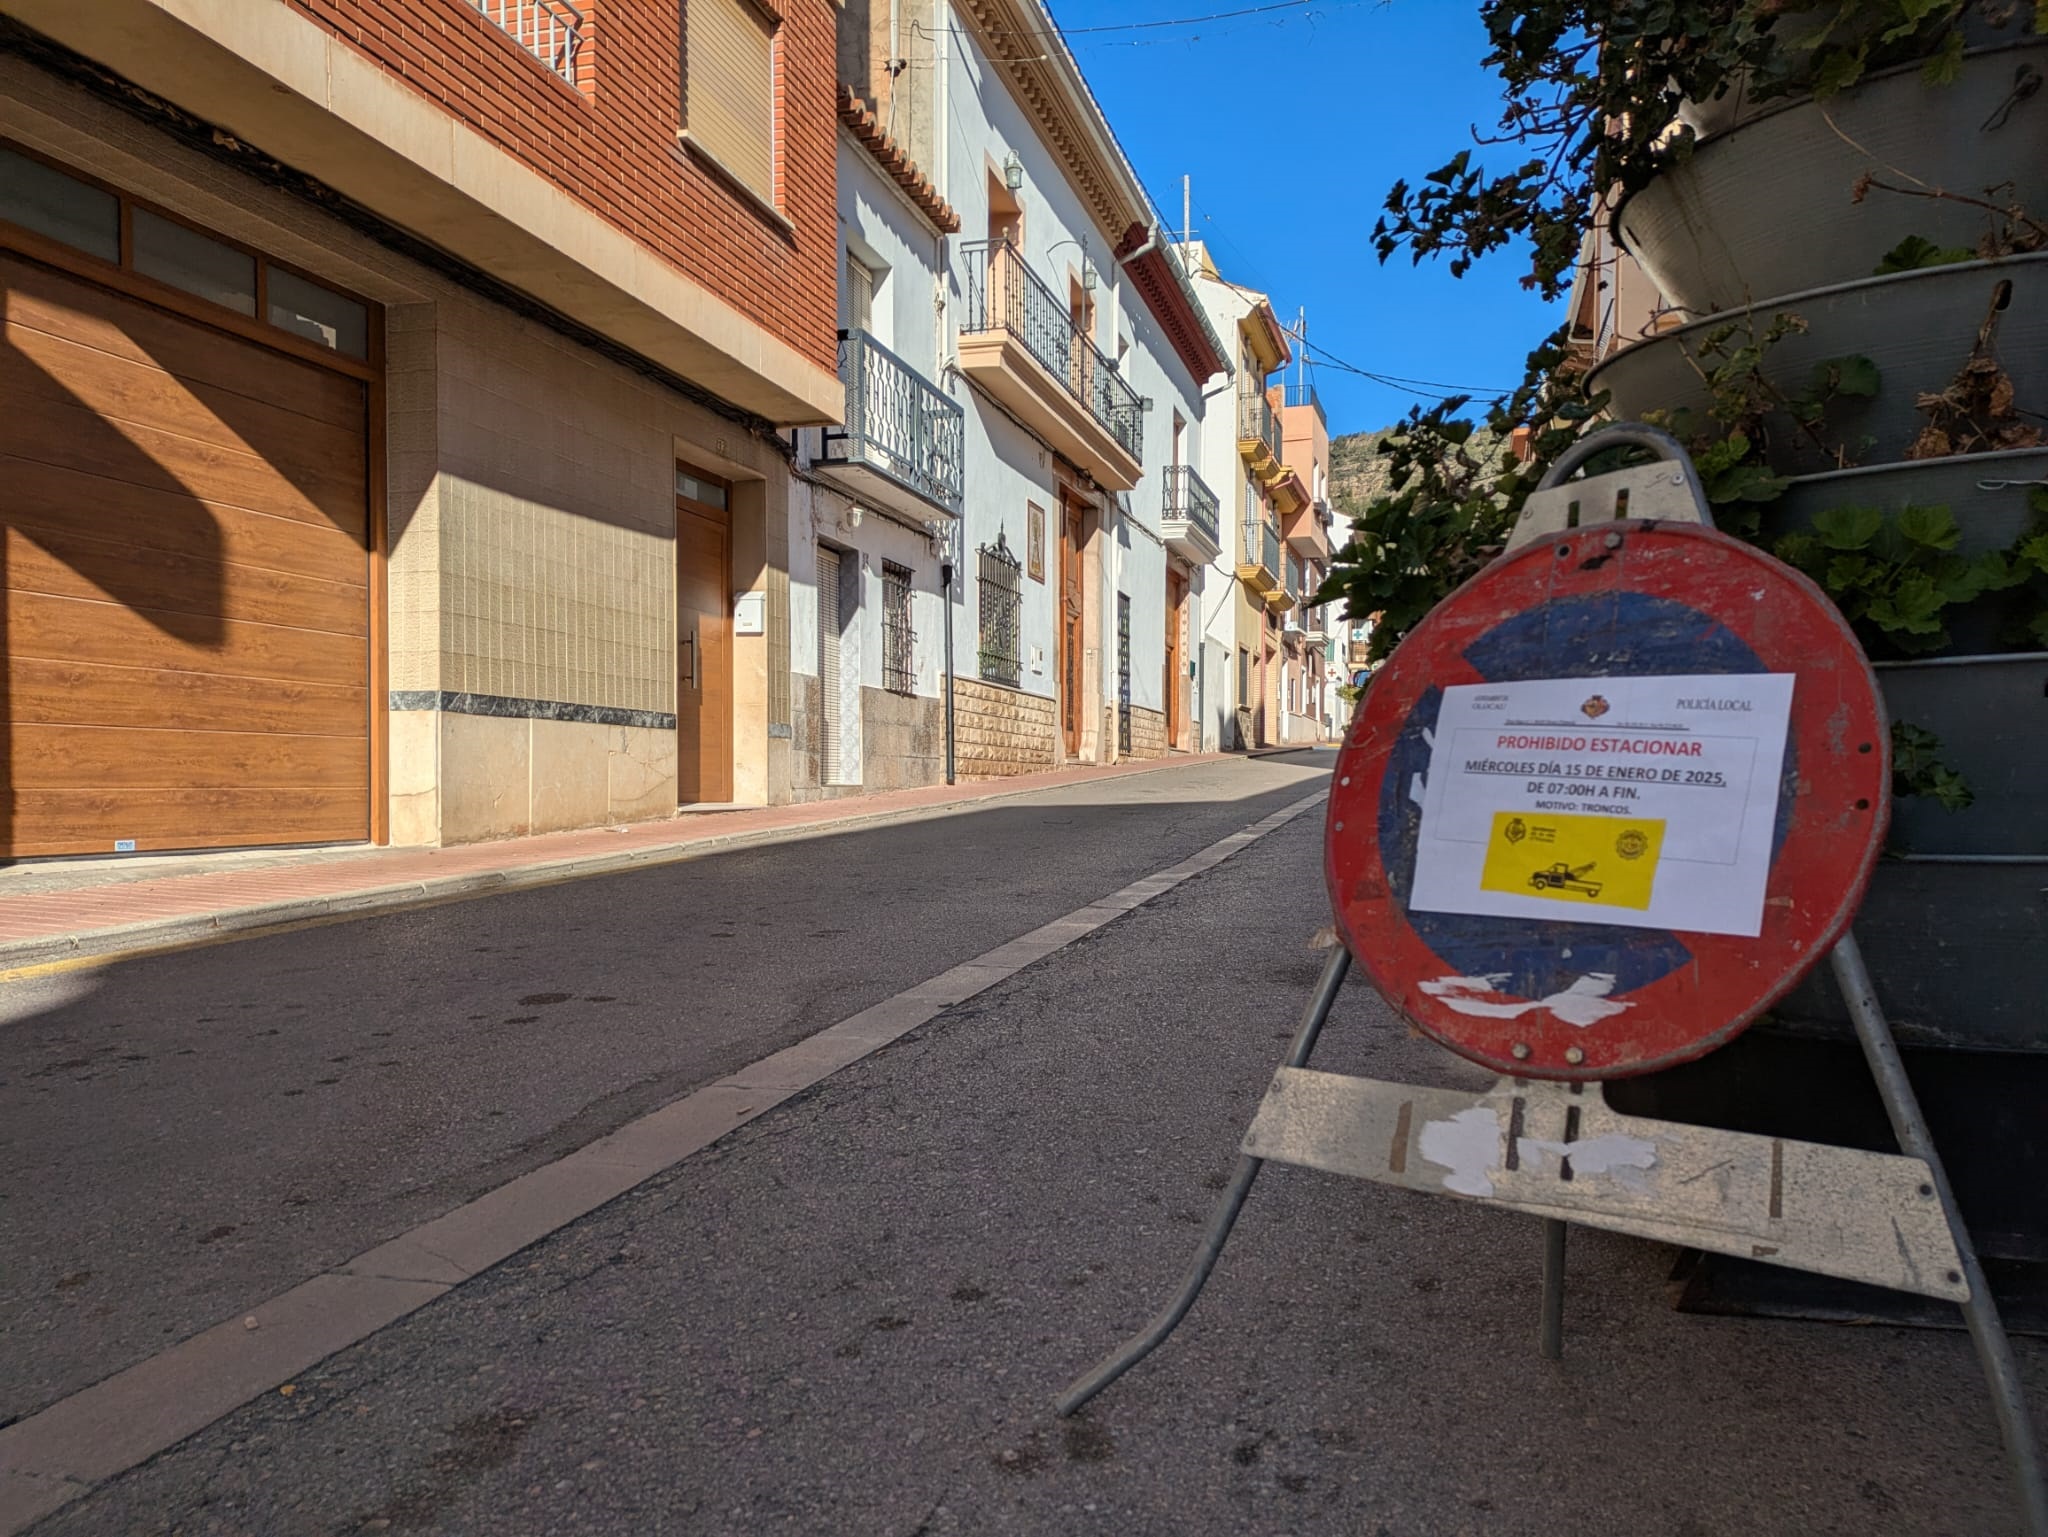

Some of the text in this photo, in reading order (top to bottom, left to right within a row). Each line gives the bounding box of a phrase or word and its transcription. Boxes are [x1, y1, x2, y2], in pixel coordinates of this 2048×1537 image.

[1676, 698, 1752, 711] POLICÍA LOCAL
[1497, 735, 1702, 756] PROHIBIDO ESTACIONAR
[1465, 759, 1727, 787] MIÉRCOLES DÍA 15 DE ENERO DE 2025,
[1527, 782, 1640, 800] DE 07:00H A FIN.
[1536, 801, 1632, 815] MOTIVO: TRONCOS.
